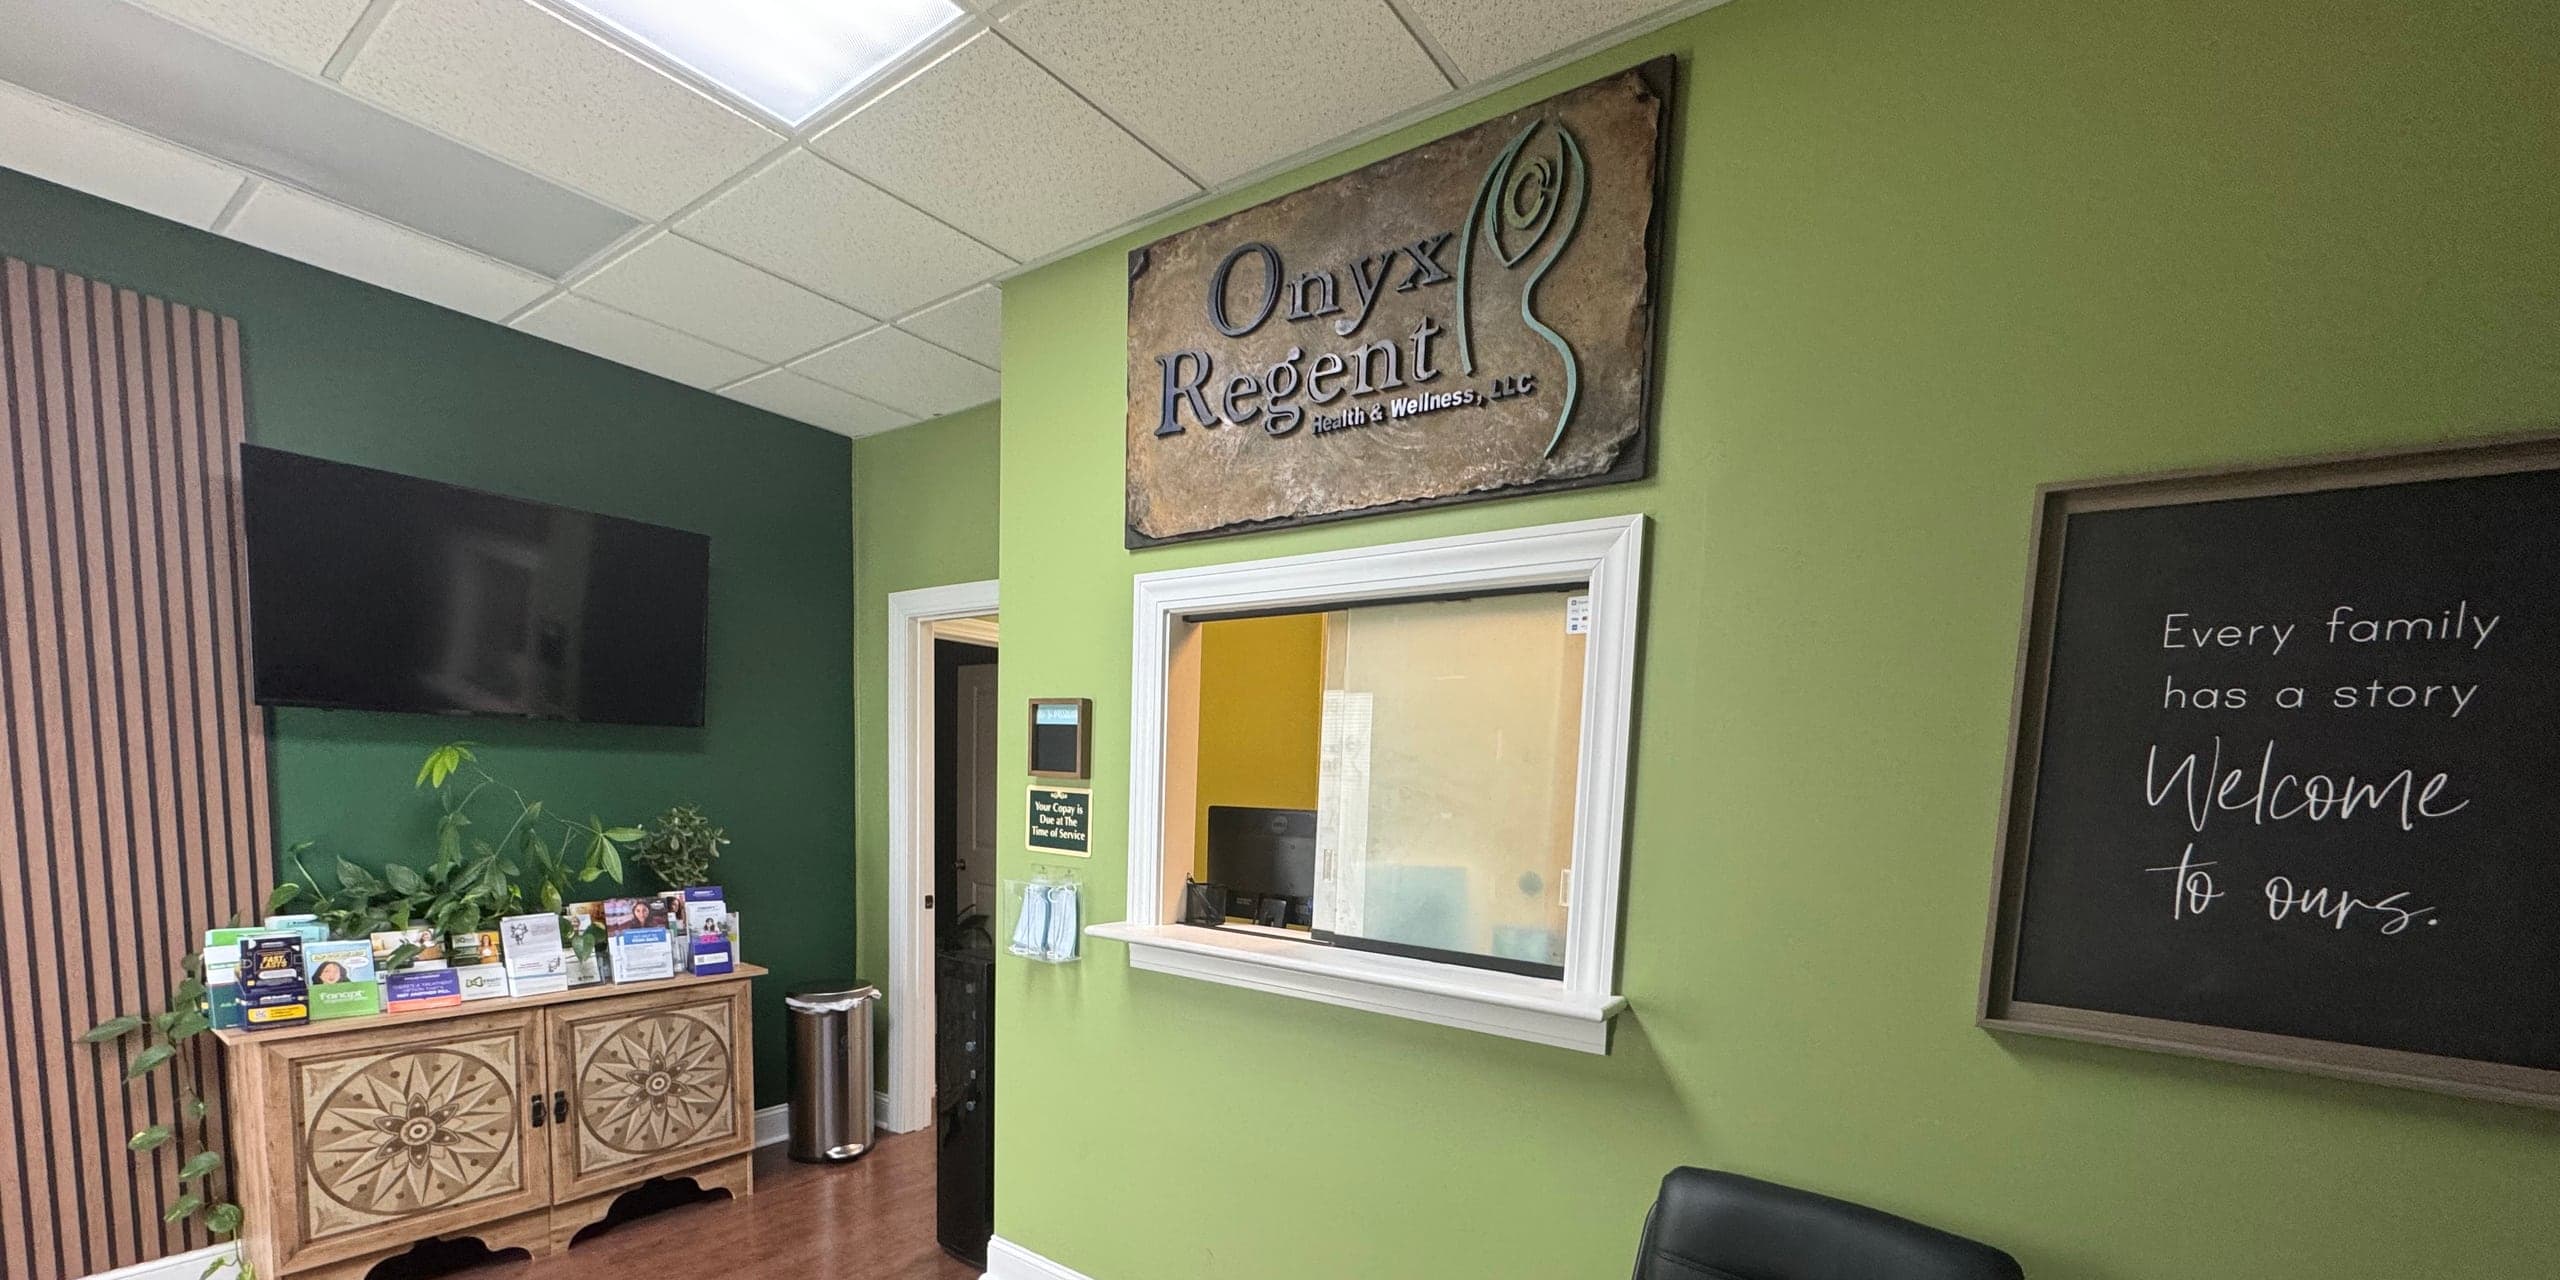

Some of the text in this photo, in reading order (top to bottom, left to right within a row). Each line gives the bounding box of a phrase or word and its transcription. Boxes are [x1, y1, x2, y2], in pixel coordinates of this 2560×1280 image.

[1206, 230, 1454, 338] Onyx
[1153, 317, 1446, 439] Regent
[1311, 373, 1536, 434] Health & Wellness, LLC
[2162, 599, 2500, 656] Every family
[2163, 674, 2478, 718] has a story
[1035, 801, 1083, 816] Your Copay is
[2144, 735, 2470, 832] Welcome
[1032, 825, 1086, 840] Time of Service
[1039, 814, 1078, 827] Due at The
[2144, 842, 2439, 935] to ours.
